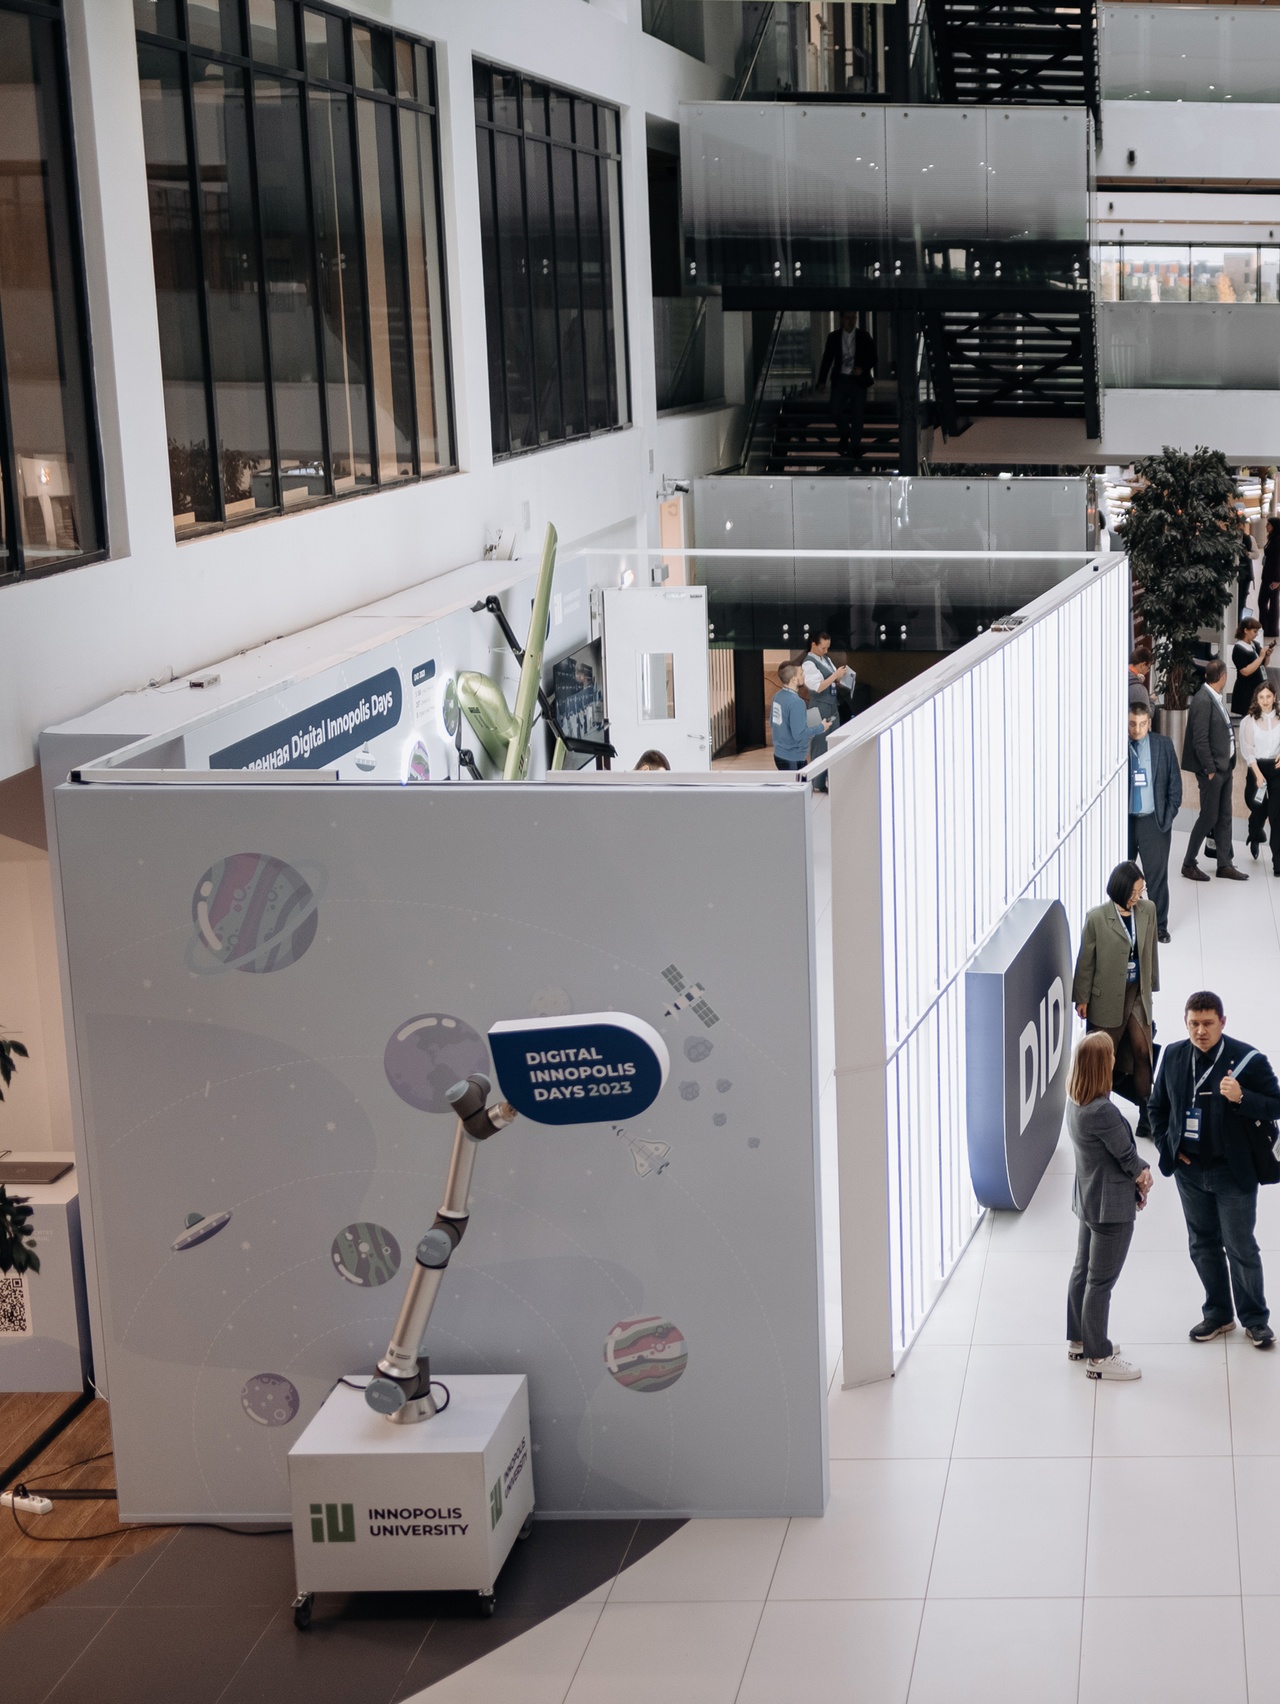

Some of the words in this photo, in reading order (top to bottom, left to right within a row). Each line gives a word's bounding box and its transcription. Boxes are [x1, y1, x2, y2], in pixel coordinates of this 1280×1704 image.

[291, 720, 326, 759] Digital
[327, 698, 370, 739] Innopolis
[371, 690, 393, 716] Days
[526, 1047, 602, 1065] DIGITAL
[1020, 976, 1064, 1136] DID
[530, 1062, 636, 1083] INNOPOLIS
[534, 1085, 585, 1101] DAYS
[588, 1081, 632, 1096] 2023
[504, 1436, 525, 1483] INNOPOLIS
[505, 1449, 527, 1499] UNIVERSITY
[368, 1508, 462, 1520] INNOPOLIS
[370, 1524, 469, 1536] UNIVERSITY
